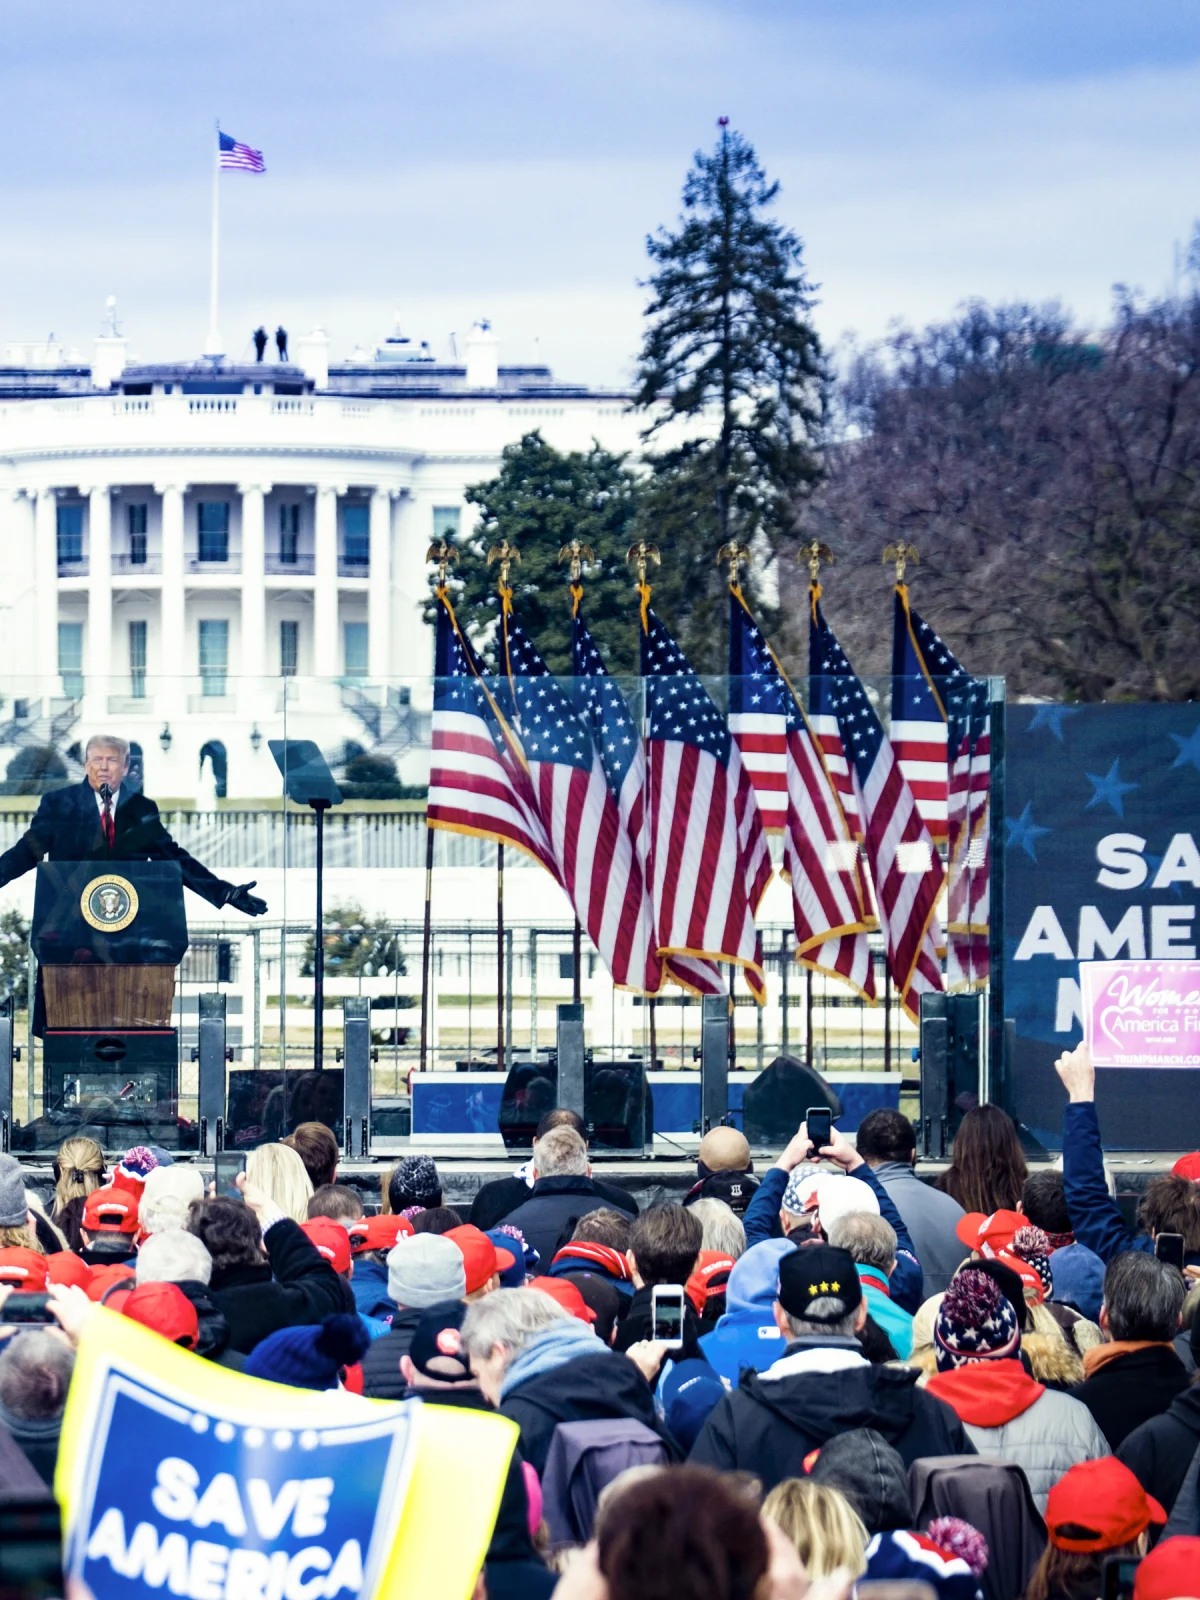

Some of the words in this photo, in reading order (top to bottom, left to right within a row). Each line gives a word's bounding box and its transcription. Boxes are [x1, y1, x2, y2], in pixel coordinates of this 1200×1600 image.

[1096, 832, 1200, 890] SA
[1013, 905, 1196, 960] AME
[1111, 1015, 1180, 1033] America
[151, 1457, 334, 1541] SAVE
[87, 1507, 363, 1600] AMERICA
